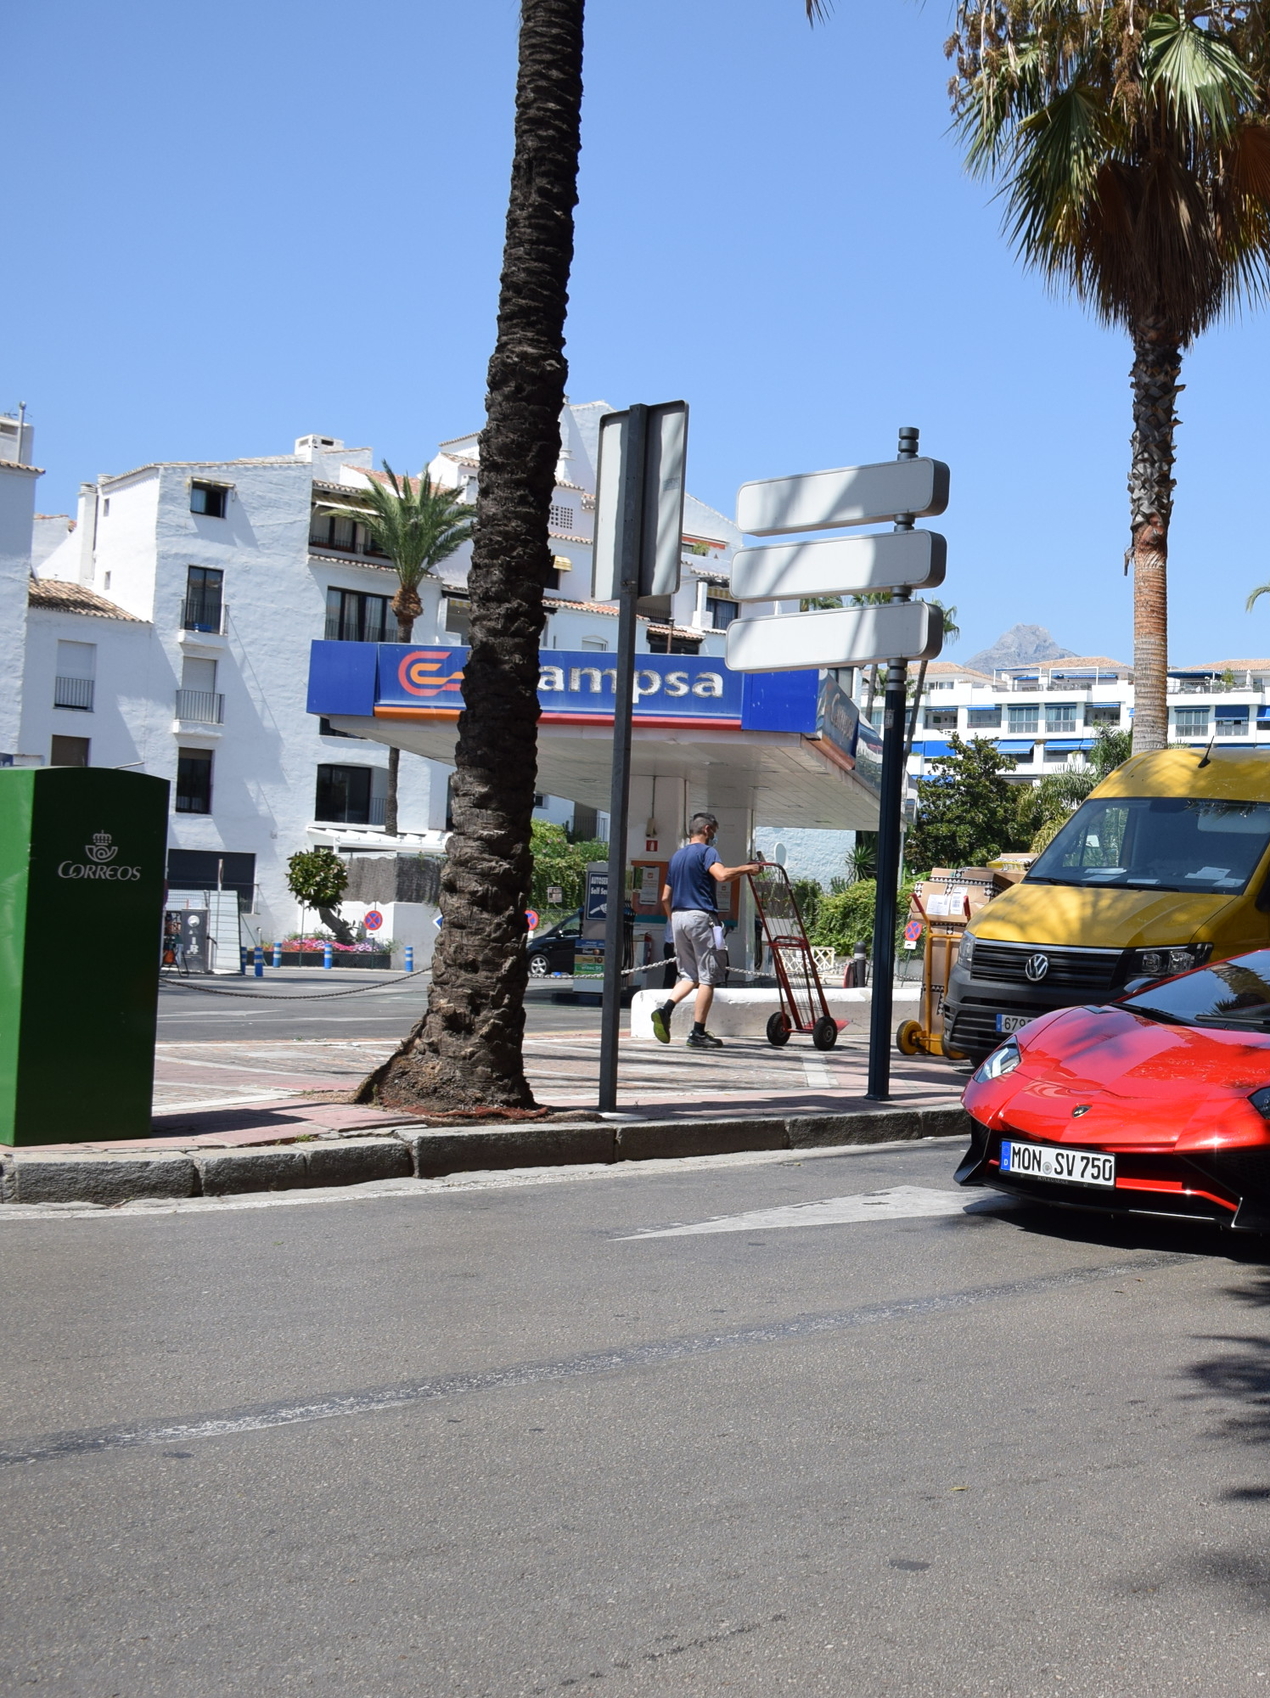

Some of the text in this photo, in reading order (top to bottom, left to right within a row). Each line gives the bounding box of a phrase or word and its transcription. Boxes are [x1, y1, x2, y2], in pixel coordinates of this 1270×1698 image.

[538, 664, 724, 703] ampsa
[57, 860, 142, 881] CORREOS
[1004, 1017, 1032, 1031] 679
[1011, 1146, 1042, 1172] MON
[1053, 1152, 1076, 1176] SV
[1080, 1155, 1113, 1181] 750
